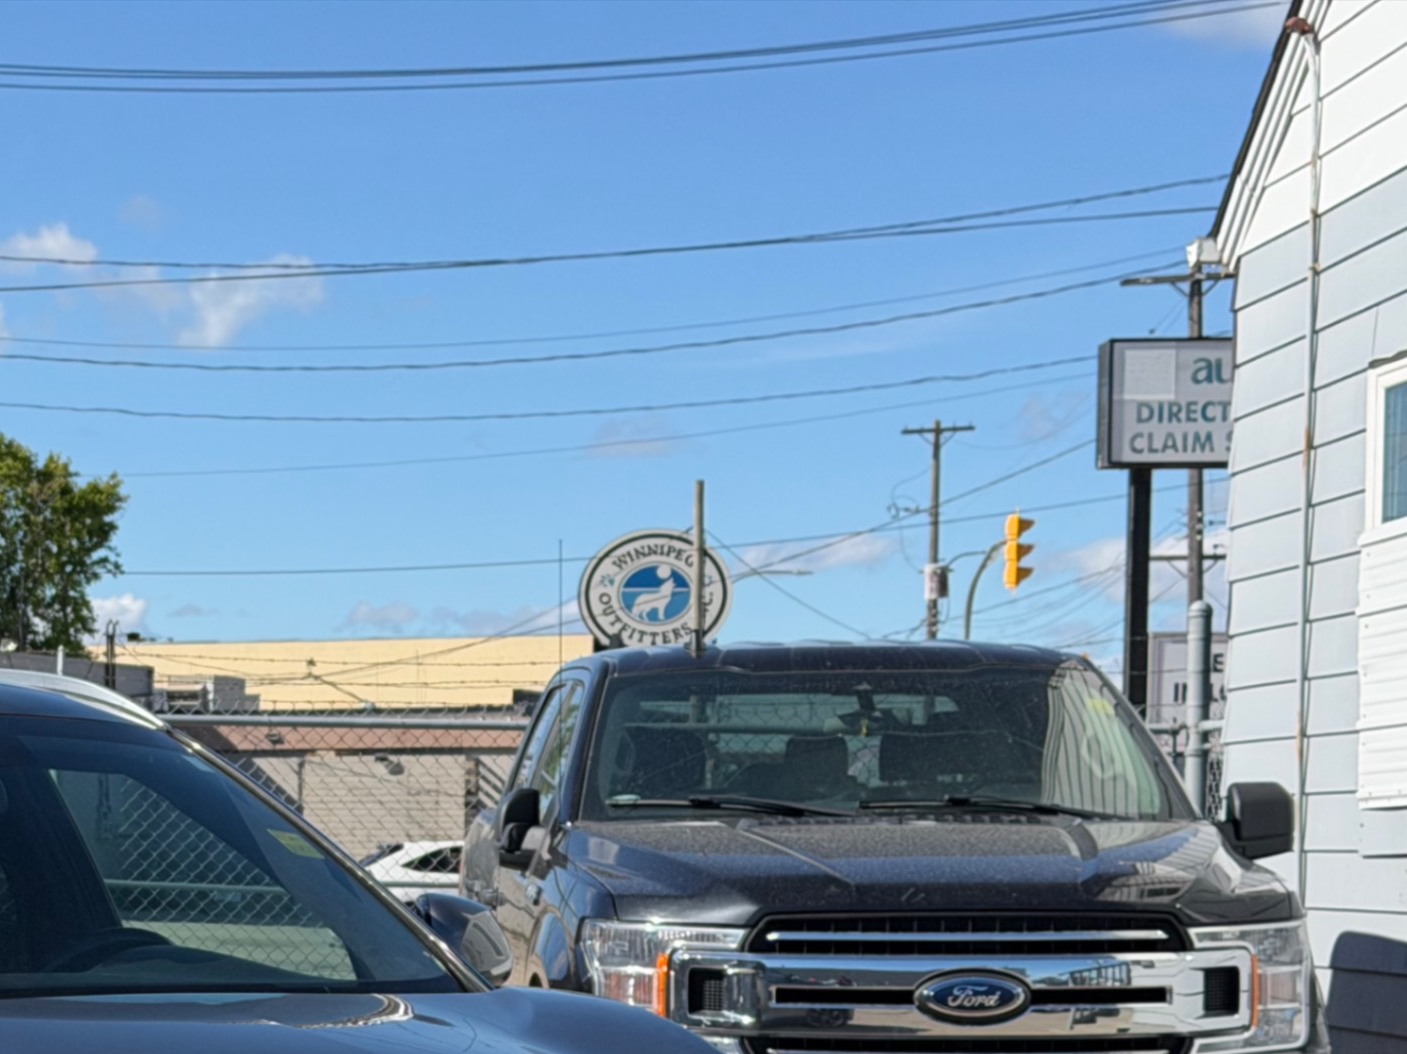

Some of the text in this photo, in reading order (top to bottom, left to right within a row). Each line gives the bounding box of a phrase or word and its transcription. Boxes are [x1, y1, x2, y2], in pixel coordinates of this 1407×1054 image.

[1135, 401, 1231, 424] DIRECT
[1129, 430, 1215, 454] CLAIM
[599, 592, 693, 646] OUTFITTERS
[947, 985, 1001, 1008] Ford
